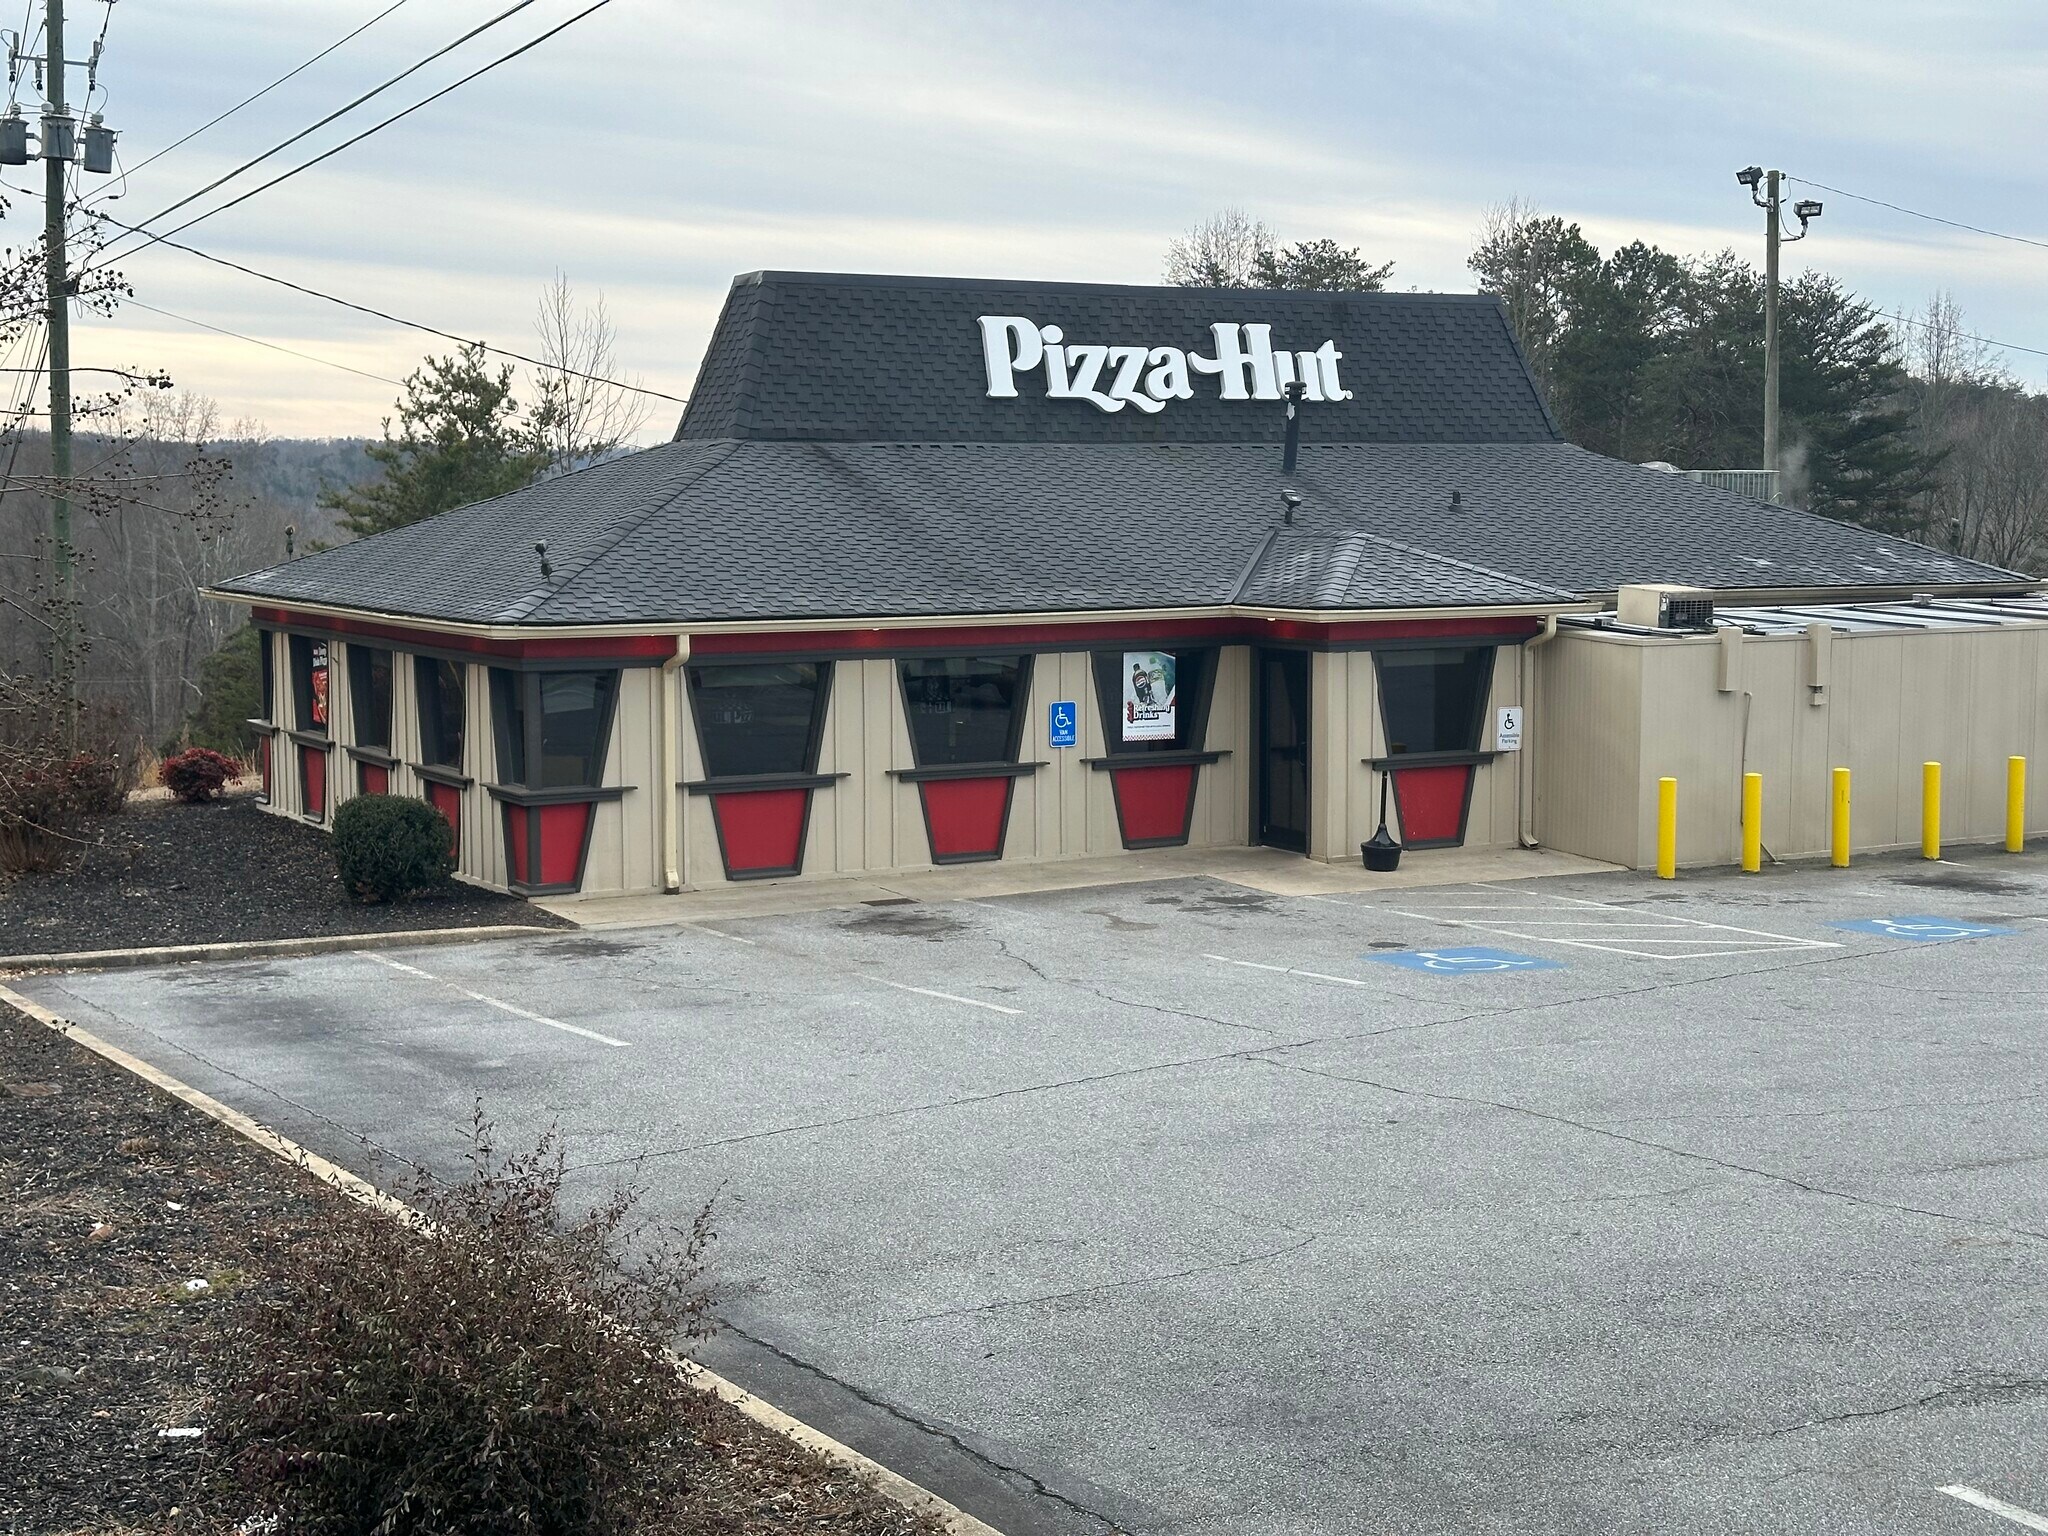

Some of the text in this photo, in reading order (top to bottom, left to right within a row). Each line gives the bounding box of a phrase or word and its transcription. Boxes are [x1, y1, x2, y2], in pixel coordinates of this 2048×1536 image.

[977, 315, 1344, 414] Pizza Hut
[1133, 712, 1159, 720] Drinks
